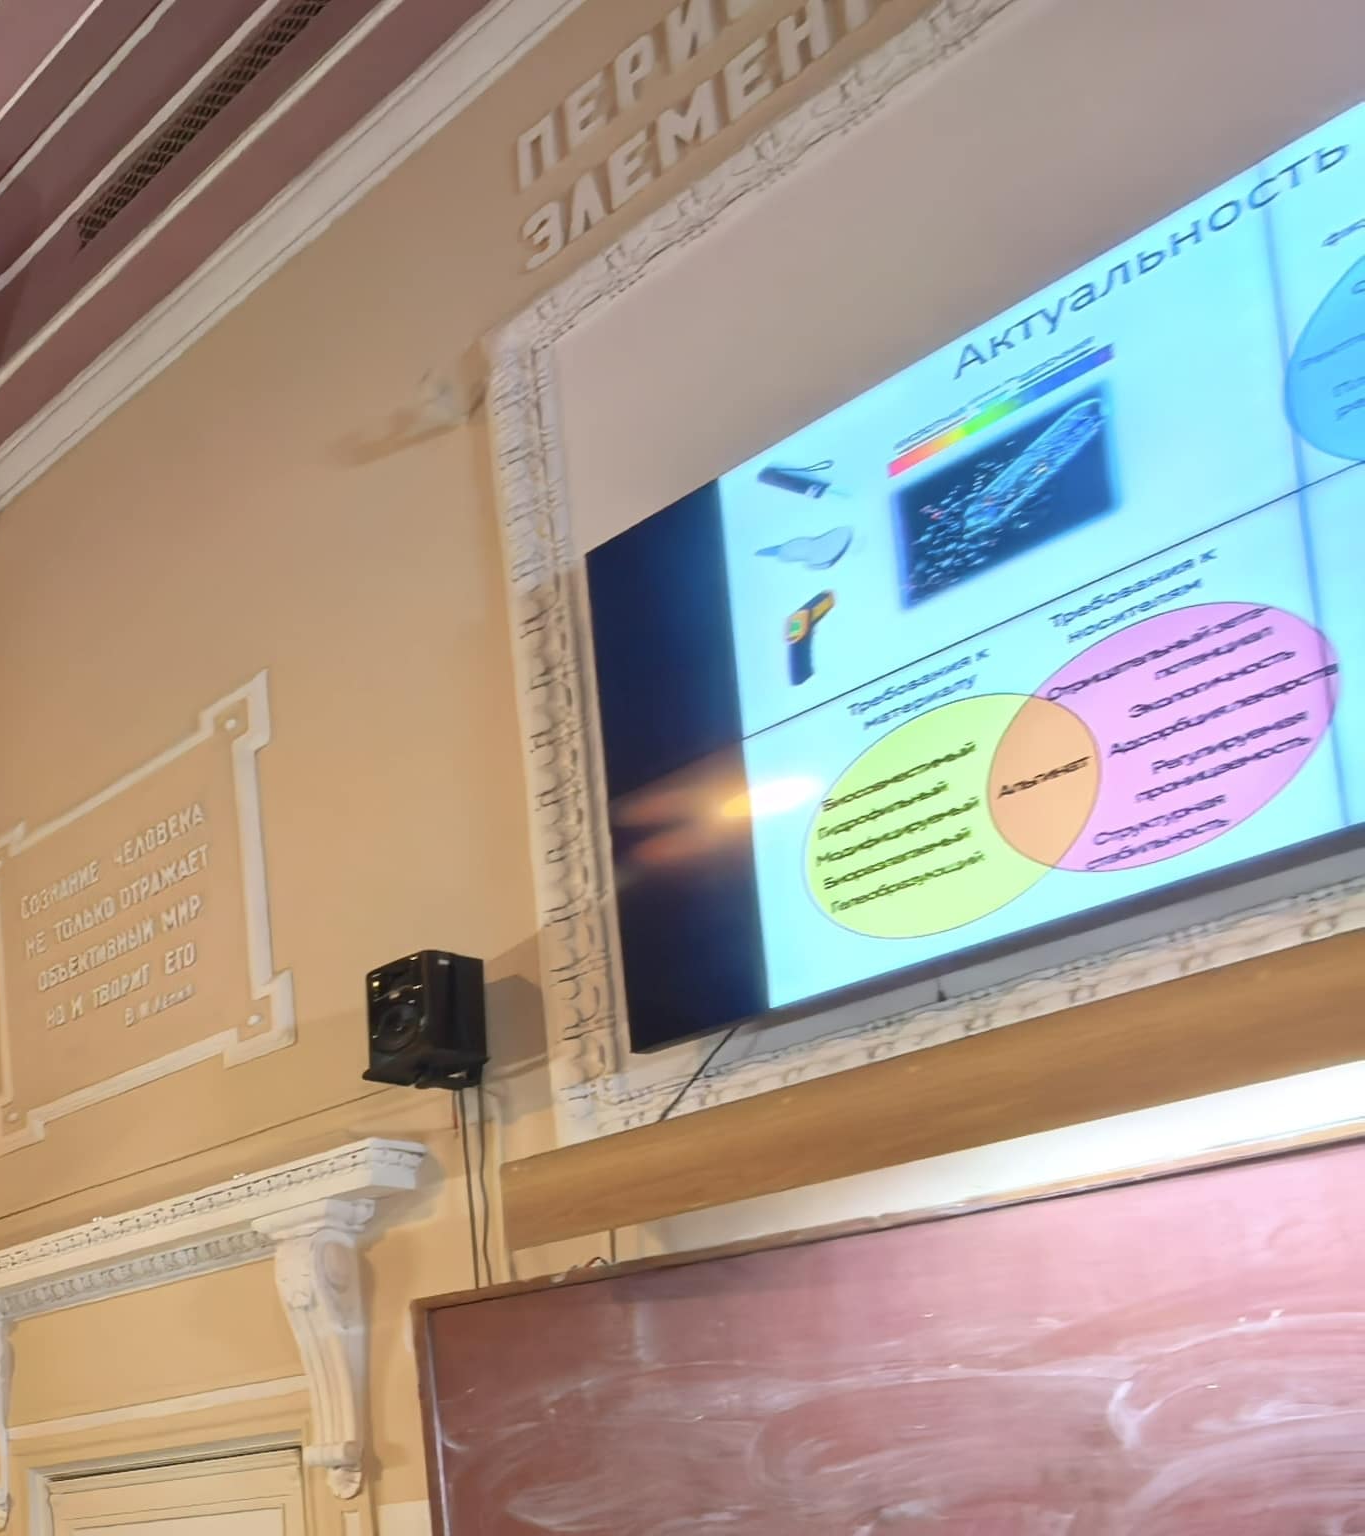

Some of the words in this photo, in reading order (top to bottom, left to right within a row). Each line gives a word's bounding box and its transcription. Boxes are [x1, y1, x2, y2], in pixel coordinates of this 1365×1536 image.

[516, 0, 763, 194] ПЕРИ
[952, 144, 1349, 380] Актуальность
[1049, 559, 1195, 628] Требования
[1199, 548, 1218, 563] к
[1067, 578, 1203, 643] носителям
[847, 656, 971, 715] Требования
[975, 649, 989, 661] к
[863, 674, 978, 730] материалу
[25, 930, 47, 960] НЕ
[53, 896, 116, 943] ТОЛЬКО
[119, 844, 209, 911] ОТРАЖАЕТ
[161, 894, 204, 933] МИР
[92, 963, 150, 1009] ТВОРИТ
[164, 941, 198, 976] ЕГО
